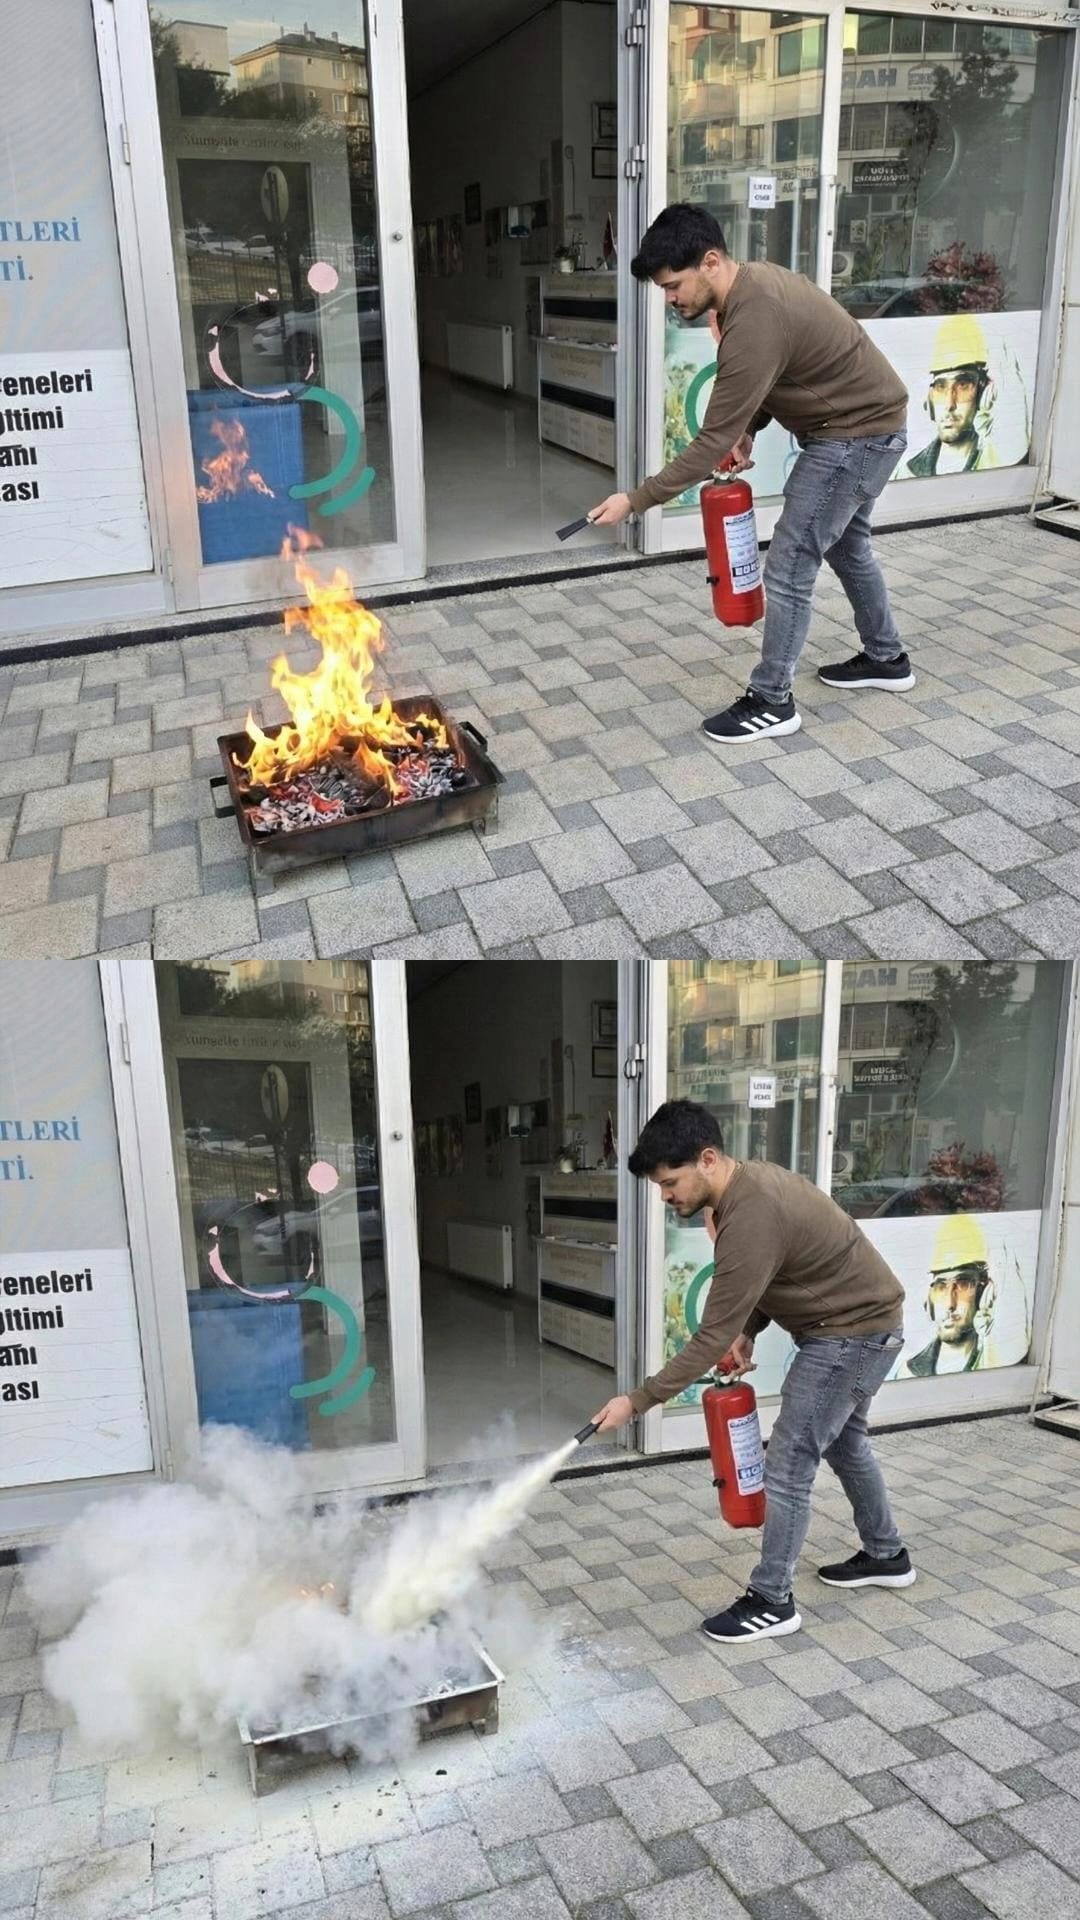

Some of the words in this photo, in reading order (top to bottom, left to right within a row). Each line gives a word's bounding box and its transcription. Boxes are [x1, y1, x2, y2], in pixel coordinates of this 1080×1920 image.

[0, 216, 81, 241] TLERİ
[0, 369, 93, 396] eneleri
[0, 481, 39, 502] ası
[0, 1116, 81, 1141] TLERİ
[0, 1268, 93, 1296] eneleri
